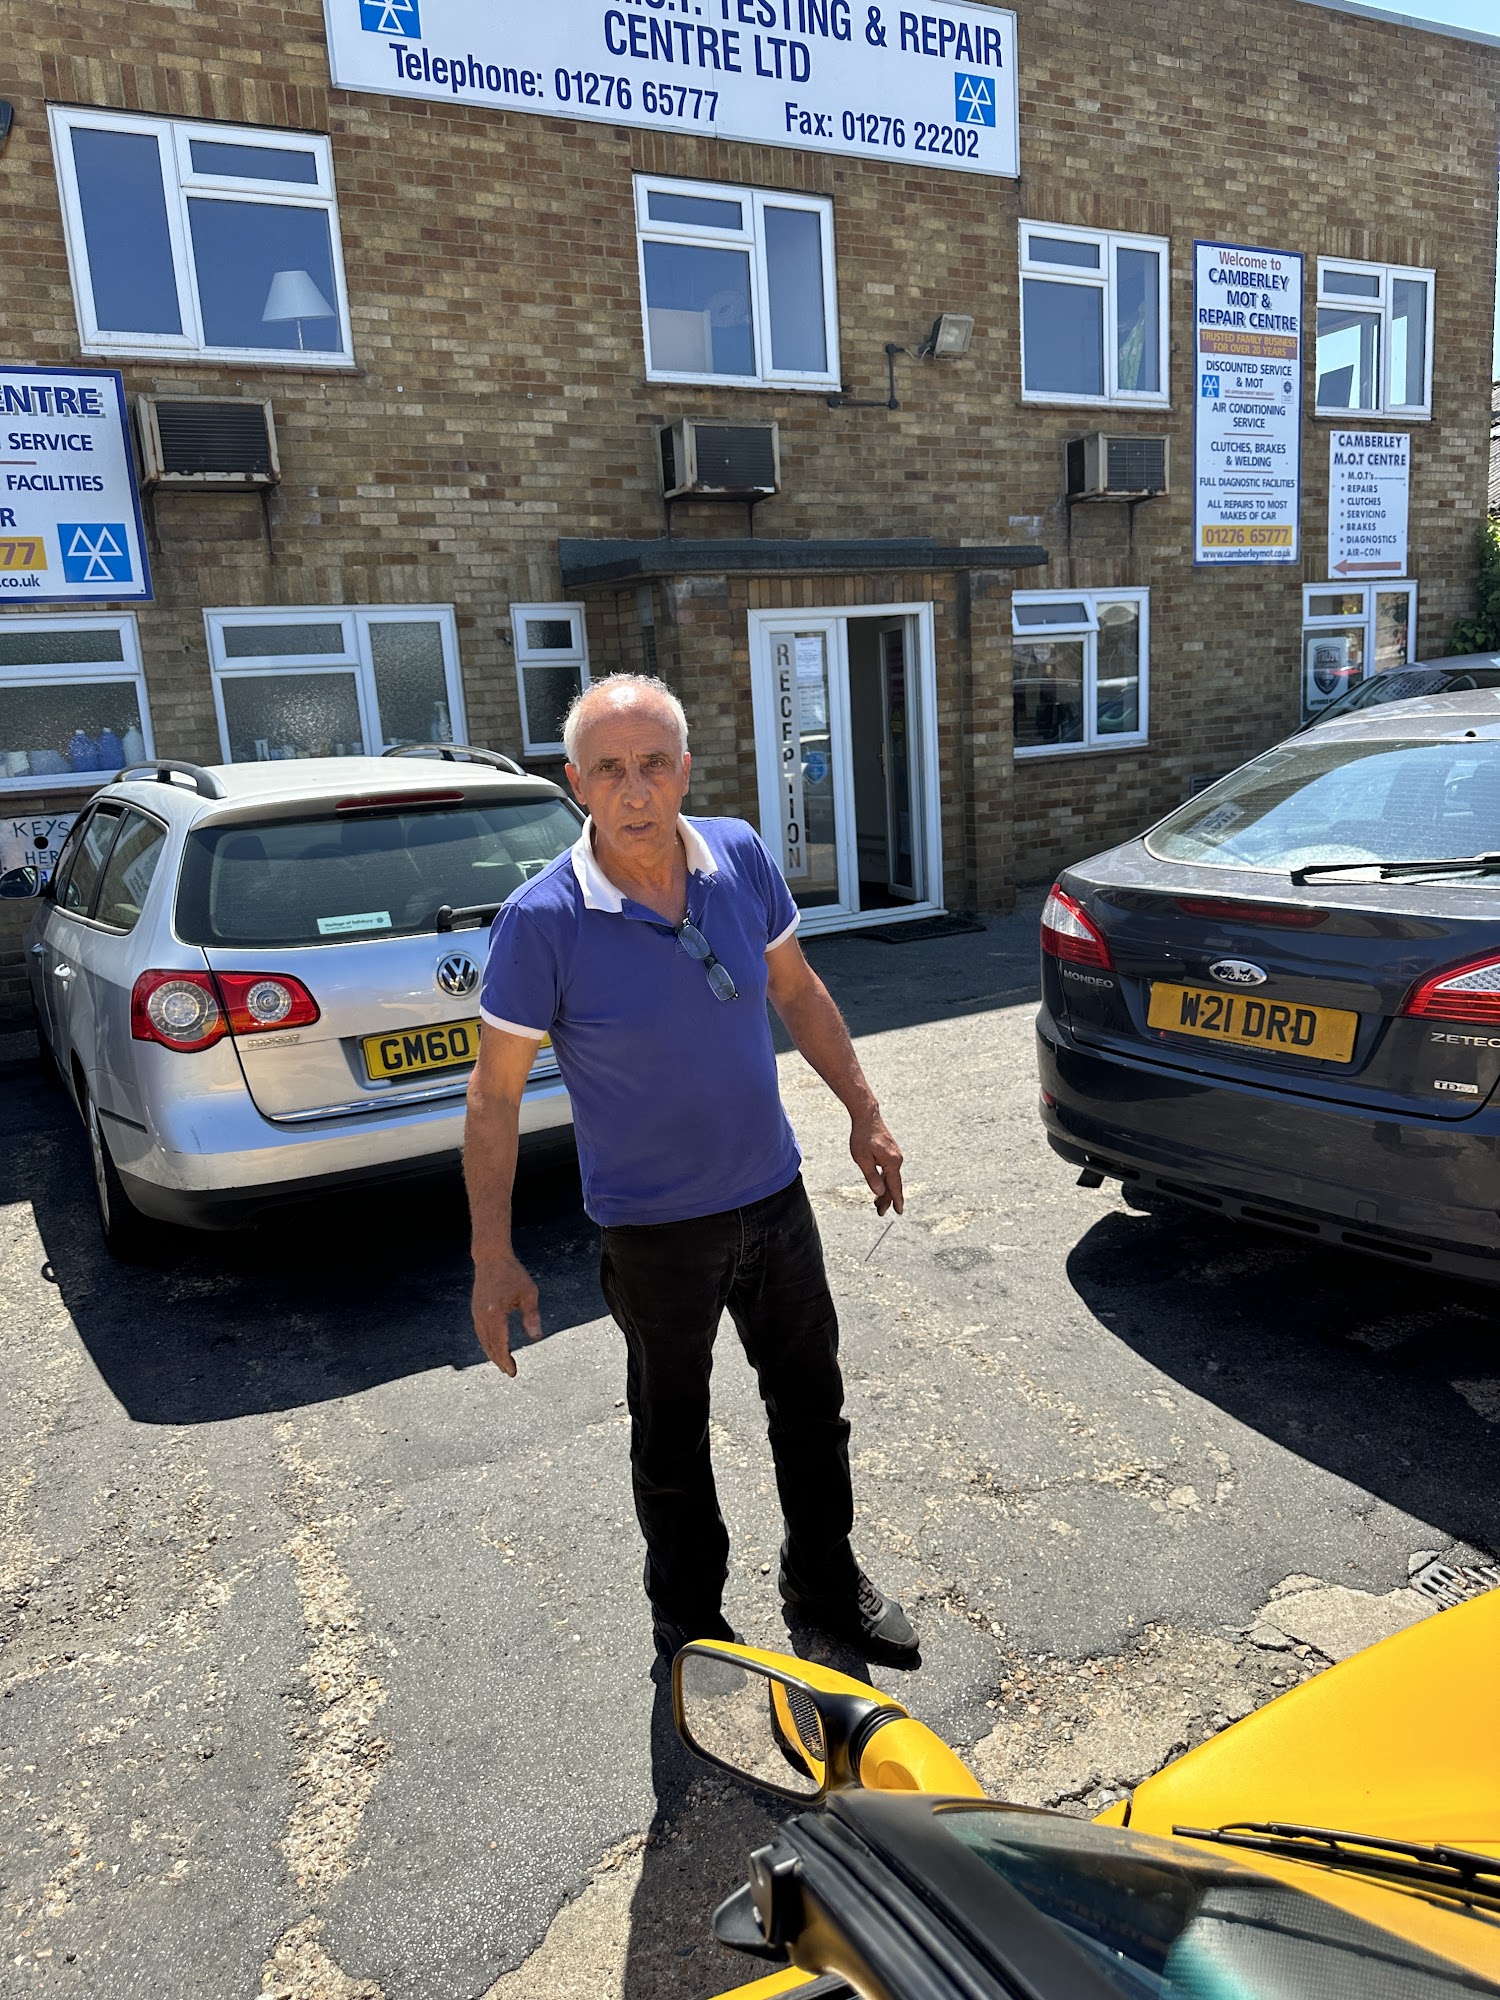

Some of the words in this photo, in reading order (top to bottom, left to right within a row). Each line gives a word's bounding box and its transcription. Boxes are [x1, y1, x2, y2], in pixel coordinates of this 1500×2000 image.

[865, 6, 887, 47] &
[899, 11, 1003, 67] REPAIR
[604, 9, 742, 73] CENTRE
[754, 34, 811, 82] LTD
[389, 42, 544, 97] Telephone:
[555, 68, 632, 110] 01276
[643, 81, 719, 122] 65777
[785, 101, 833, 137] Fax:
[842, 111, 905, 148] 01276
[914, 121, 979, 158] 22202
[1219, 251, 1267, 269] Welcome
[1270, 257, 1282, 271] to
[1208, 267, 1289, 290] CAMBERLEY
[1227, 290, 1257, 308] MOT
[1261, 293, 1271, 309] &
[1200, 308, 1244, 326] REPAIR
[1249, 312, 1298, 331] CENTRE
[1202, 331, 1235, 342] TRUSTED
[1236, 334, 1263, 345] FAMILY
[1264, 336, 1296, 348] BUSINESS
[1213, 343, 1228, 352] FOR
[1230, 344, 1250, 353] OVER
[1252, 346, 1261, 354] 20
[1263, 347, 1287, 357] YEARS
[1206, 360, 1258, 374] DISCOUNTED
[1260, 363, 1292, 376] SERVICE
[1236, 376, 1243, 387] &
[1245, 377, 1264, 389] MOT
[0, 384, 102, 415] NTRE
[1212, 402, 1226, 413] AIR
[1229, 403, 1286, 416] CONDITIONING
[1233, 417, 1266, 429] SERVICE
[8, 432, 94, 451] SERVICE
[1211, 441, 1252, 454] CLUTCHES,
[1255, 443, 1286, 454] BRAKES
[1338, 434, 1403, 448] CAMBERLEY
[1226, 456, 1232, 466] &
[1235, 456, 1272, 467] WELDING
[1334, 452, 1365, 465] M.O.T
[1367, 453, 1406, 466] CENTRE
[6, 474, 104, 491] FACILITIES
[1200, 477, 1216, 487] FULL
[1218, 477, 1260, 488] DIAGNOSTIC
[1262, 478, 1295, 488] FACILITIES
[1347, 484, 1378, 493] REPAIRS
[1207, 500, 1222, 509] ALL
[1224, 500, 1254, 509] REPAIRS
[1256, 500, 1265, 509] TO
[1267, 500, 1288, 509] MOST
[1347, 497, 1381, 506] CLUTCHES
[1220, 511, 1247, 520] MAKES
[1249, 511, 1259, 520] OF
[1261, 511, 1276, 520] CAR
[1346, 510, 1386, 519] SERVICING
[1346, 523, 1376, 531] BRAKES
[1206, 528, 1245, 544] 01276
[1250, 528, 1289, 544] 65777
[1346, 535, 1397, 544] DIAGNOSTICS
[1203, 548, 1291, 560] www.camberleymot.co.uk
[1346, 548, 1381, 557] AIR-CON
[776, 643, 801, 868] RECEPTION
[13, 819, 70, 838] KEYS
[1063, 969, 1114, 989] MONDEO
[1219, 965, 1252, 982] Ford
[1180, 991, 1234, 1033] W21
[1242, 1001, 1317, 1047] DRD
[248, 1034, 300, 1048] PASSAT
[1431, 1032, 1500, 1048] ZETEC
[380, 1026, 470, 1071] GM60
